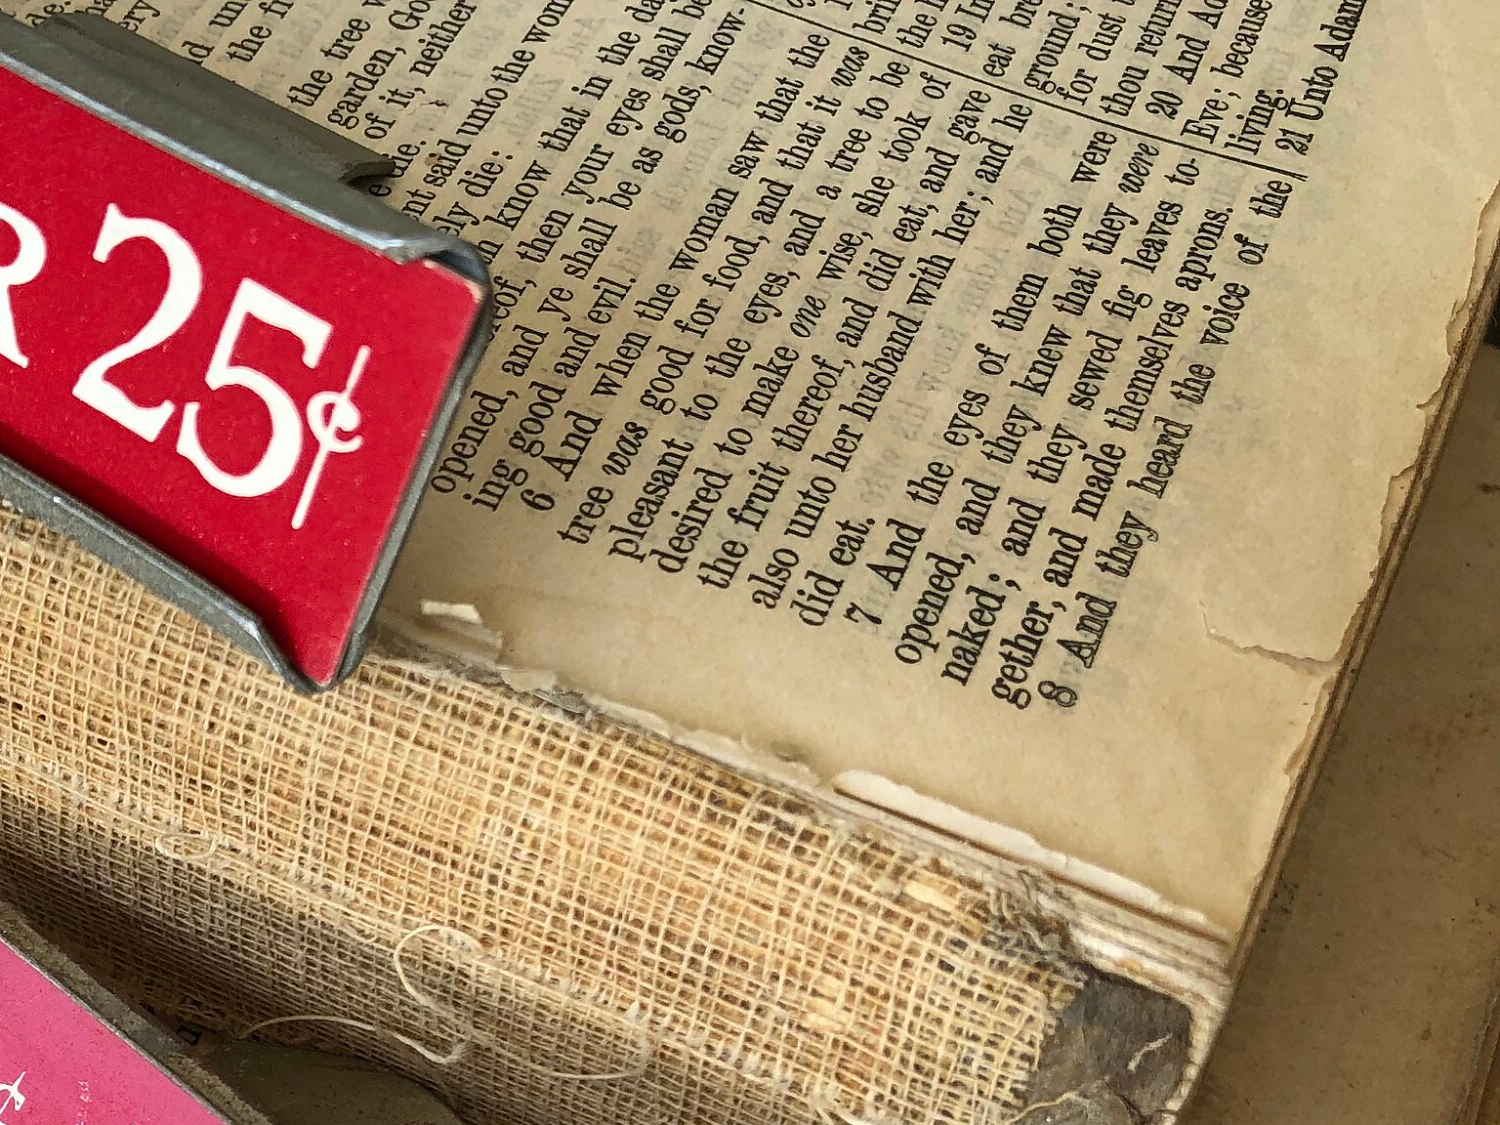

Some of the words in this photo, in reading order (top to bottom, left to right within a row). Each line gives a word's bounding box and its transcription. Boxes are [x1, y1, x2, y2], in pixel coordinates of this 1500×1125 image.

[225, 25, 272, 62] the
[408, 0, 477, 77] neither
[894, 0, 938, 48] the
[939, 21, 977, 53] 19
[1209, 0, 1272, 78] because
[286, 69, 333, 107] the
[319, 17, 371, 60] tree
[326, 46, 406, 130] garden,
[868, 57, 913, 88] be
[982, 41, 1016, 86] eat
[1049, 67, 1098, 108] for
[1076, 12, 1126, 61] dust
[1161, 33, 1210, 86] And
[377, 86, 426, 108] it,
[422, 138, 471, 188] said
[455, 79, 508, 135] unto
[489, 49, 536, 87] the
[850, 93, 889, 120] to
[946, 89, 992, 145] gave
[990, 103, 1033, 133] he
[1098, 65, 1150, 117] thou
[1144, 90, 1183, 120] 20
[1283, 63, 1338, 136] Unto
[363, 110, 396, 139] of
[482, 159, 552, 231] know
[537, 105, 590, 152] that
[595, 30, 641, 77] the
[514, 209, 574, 263] then
[560, 142, 614, 204] your
[605, 87, 651, 136] eyes
[636, 25, 691, 95] shall
[823, 128, 872, 172] tree
[1219, 88, 1296, 155] living.
[1274, 127, 1314, 156] 21
[456, 150, 513, 197] die:
[918, 145, 960, 193] and
[974, 134, 1014, 184] and
[1069, 127, 1118, 183] were
[1117, 141, 1159, 193] were
[1163, 157, 1200, 186] to-
[891, 201, 939, 242] eat,
[1247, 179, 1293, 218] the
[430, 389, 519, 493] opened,
[501, 323, 549, 377] and
[536, 286, 574, 322] ye
[559, 216, 618, 280] shall
[596, 180, 641, 210] be
[653, 84, 711, 143] gods,
[683, 7, 746, 76] know-
[782, 208, 826, 262] and
[1025, 204, 1082, 257] both
[1081, 201, 1139, 255] they
[1120, 191, 1183, 274] leaves
[1232, 232, 1269, 265] of
[519, 488, 555, 511] 6
[540, 409, 603, 482] And
[589, 330, 652, 396] when
[632, 283, 680, 321] the
[667, 184, 739, 270] woman
[726, 126, 769, 179] saw
[753, 76, 804, 123] that
[786, 31, 830, 69] the
[556, 485, 614, 544] tree
[601, 421, 651, 475] was
[639, 344, 695, 415] good
[672, 297, 721, 339] for
[701, 234, 771, 292] food,
[750, 176, 794, 225] and
[774, 116, 826, 170] that
[829, 45, 870, 87] was
[742, 267, 800, 324] eyes,
[856, 247, 905, 298] did
[905, 254, 956, 315] with
[1051, 266, 1102, 318] that
[648, 466, 733, 573] desired
[712, 427, 753, 456] to
[740, 345, 799, 419] make
[789, 294, 828, 338] one
[815, 230, 873, 279] wise,
[850, 175, 899, 217] she
[877, 110, 932, 163] took
[918, 70, 951, 99] of
[835, 296, 878, 348] and
[990, 273, 1048, 331] them
[1100, 284, 1153, 322] fig
[1198, 282, 1250, 345] voice
[72, 203, 370, 530] 25¢
[702, 337, 751, 378] the
[837, 309, 923, 422] husband
[974, 342, 1011, 376] of
[1009, 323, 1072, 397] knew
[1066, 329, 1123, 411] sewed
[1168, 363, 1215, 404] the
[471, 458, 528, 511] ing
[508, 380, 567, 458] good
[542, 326, 600, 378] and
[582, 276, 636, 324] evil.
[679, 393, 718, 421] to
[770, 353, 856, 452] thereof,
[942, 388, 990, 446] eyes
[810, 423, 864, 473] her
[979, 403, 1046, 464] they
[990, 600, 1067, 710] gether,
[1042, 527, 1088, 588] and
[1071, 443, 1126, 521] made
[1102, 299, 1190, 432] themselves
[1174, 207, 1233, 291] aprons.
[1025, 422, 1088, 484] they
[1126, 416, 1193, 499] heard
[607, 437, 694, 563] pleasant
[726, 460, 791, 532] fruit
[783, 475, 836, 538] unto
[905, 461, 954, 505] the
[955, 477, 1000, 535] and
[868, 518, 926, 591] And
[1000, 496, 1046, 556] and
[1093, 510, 1159, 578] they
[696, 539, 749, 589] the
[747, 547, 799, 609] also
[790, 570, 845, 626] did
[828, 517, 875, 566] eat.
[843, 601, 882, 625] 7
[894, 552, 976, 664] opened,
[1060, 591, 1117, 669] And
[1039, 679, 1078, 708] 8
